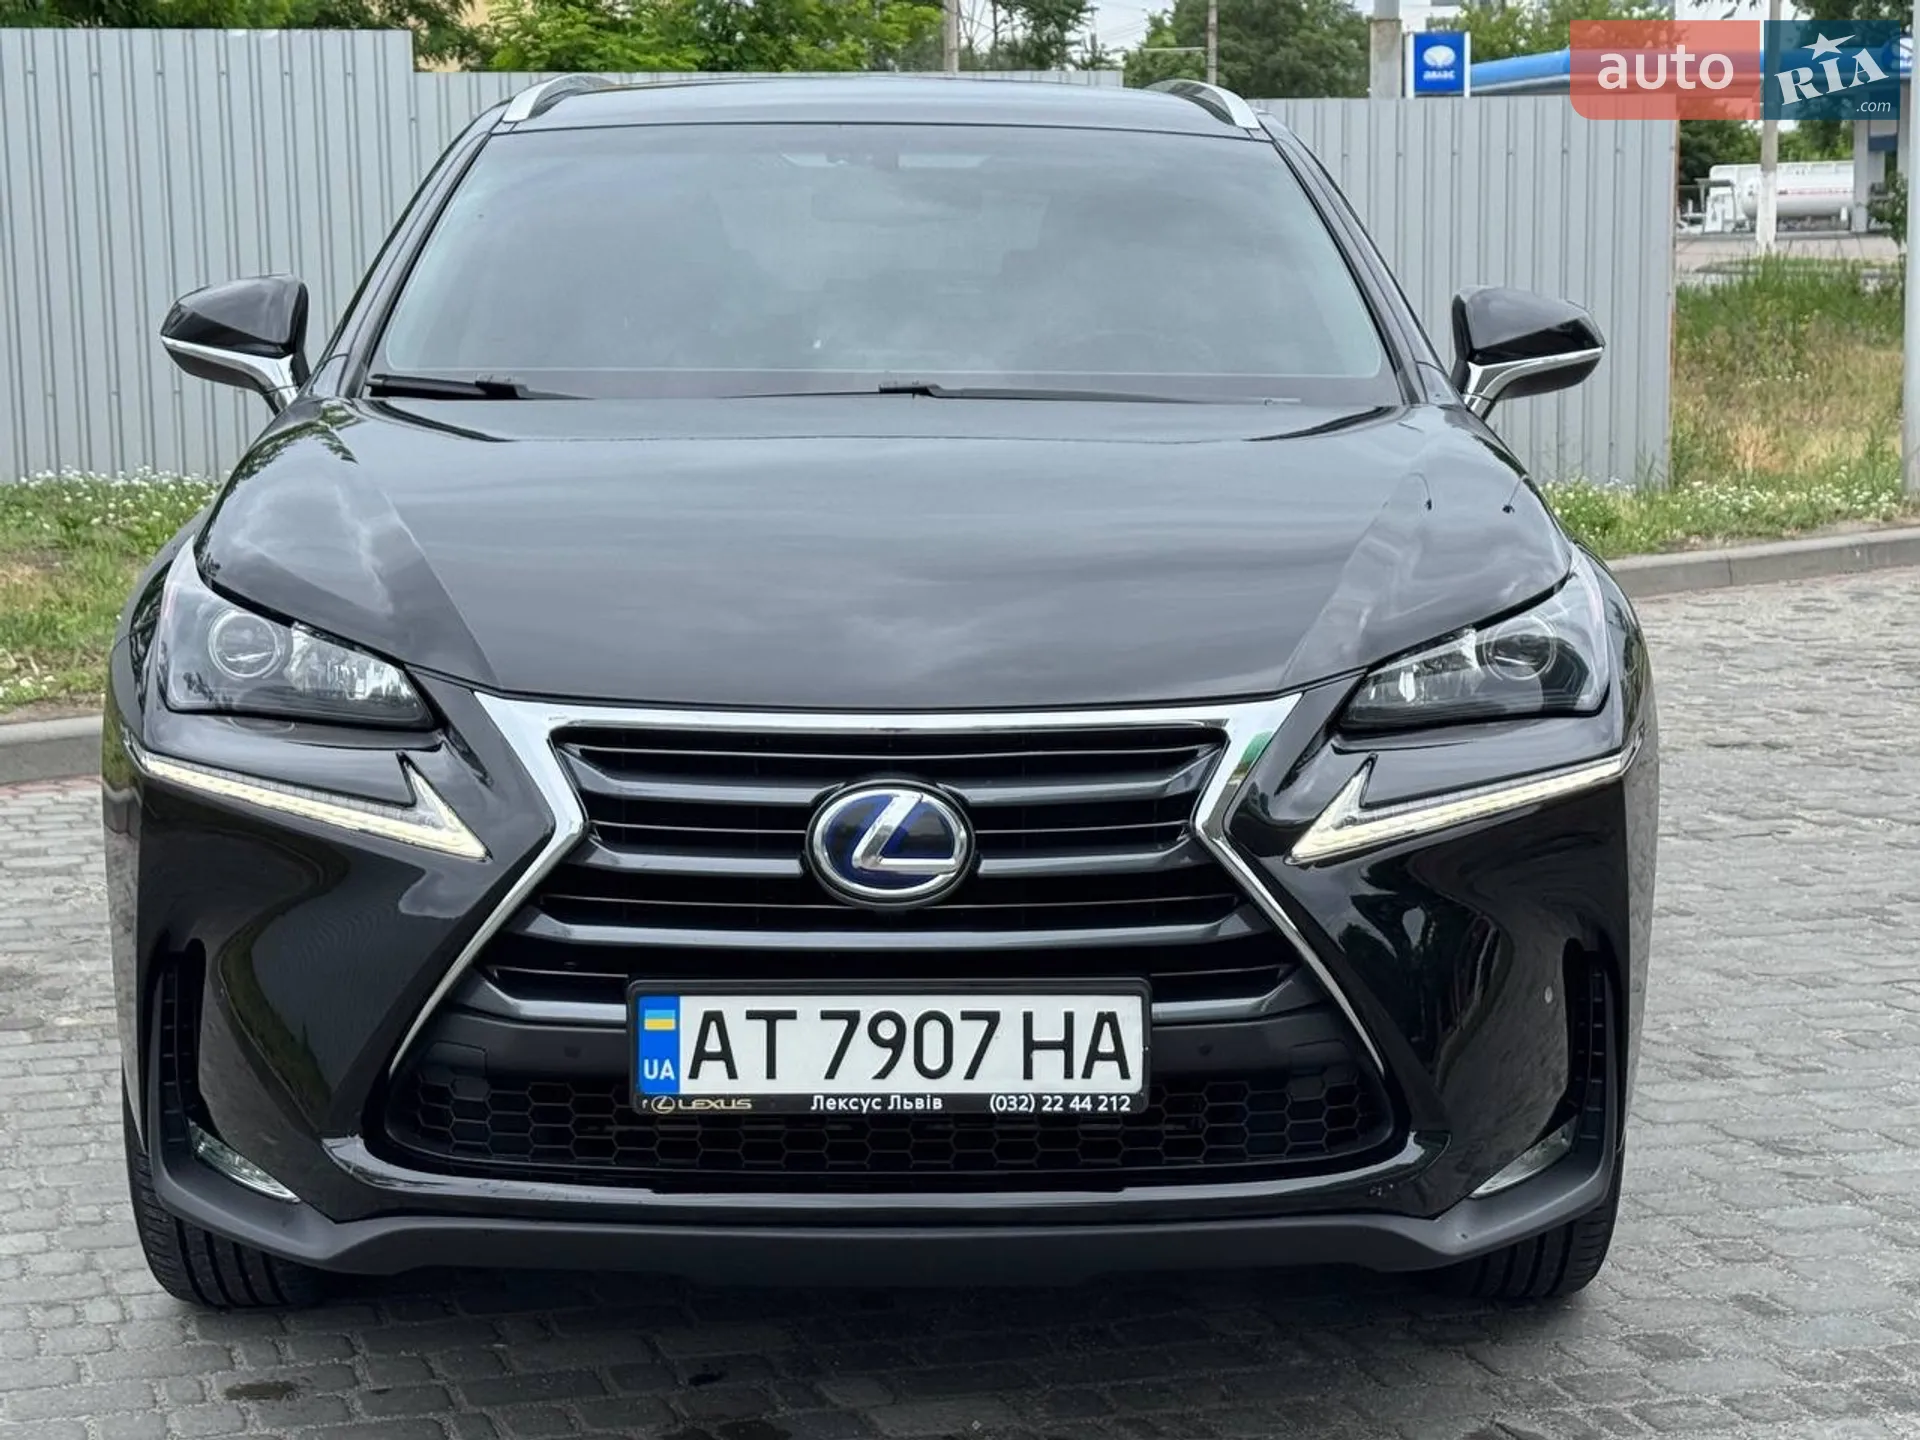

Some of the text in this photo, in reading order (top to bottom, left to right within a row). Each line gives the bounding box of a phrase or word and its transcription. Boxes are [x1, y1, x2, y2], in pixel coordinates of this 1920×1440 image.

[687, 1009, 1132, 1080] AT 7907 HA
[643, 1059, 675, 1080] UA
[678, 1098, 753, 1110] LEXUS
[811, 1094, 943, 1113] Лексус Львів
[990, 1094, 1131, 1112] (032) 22 44 212
